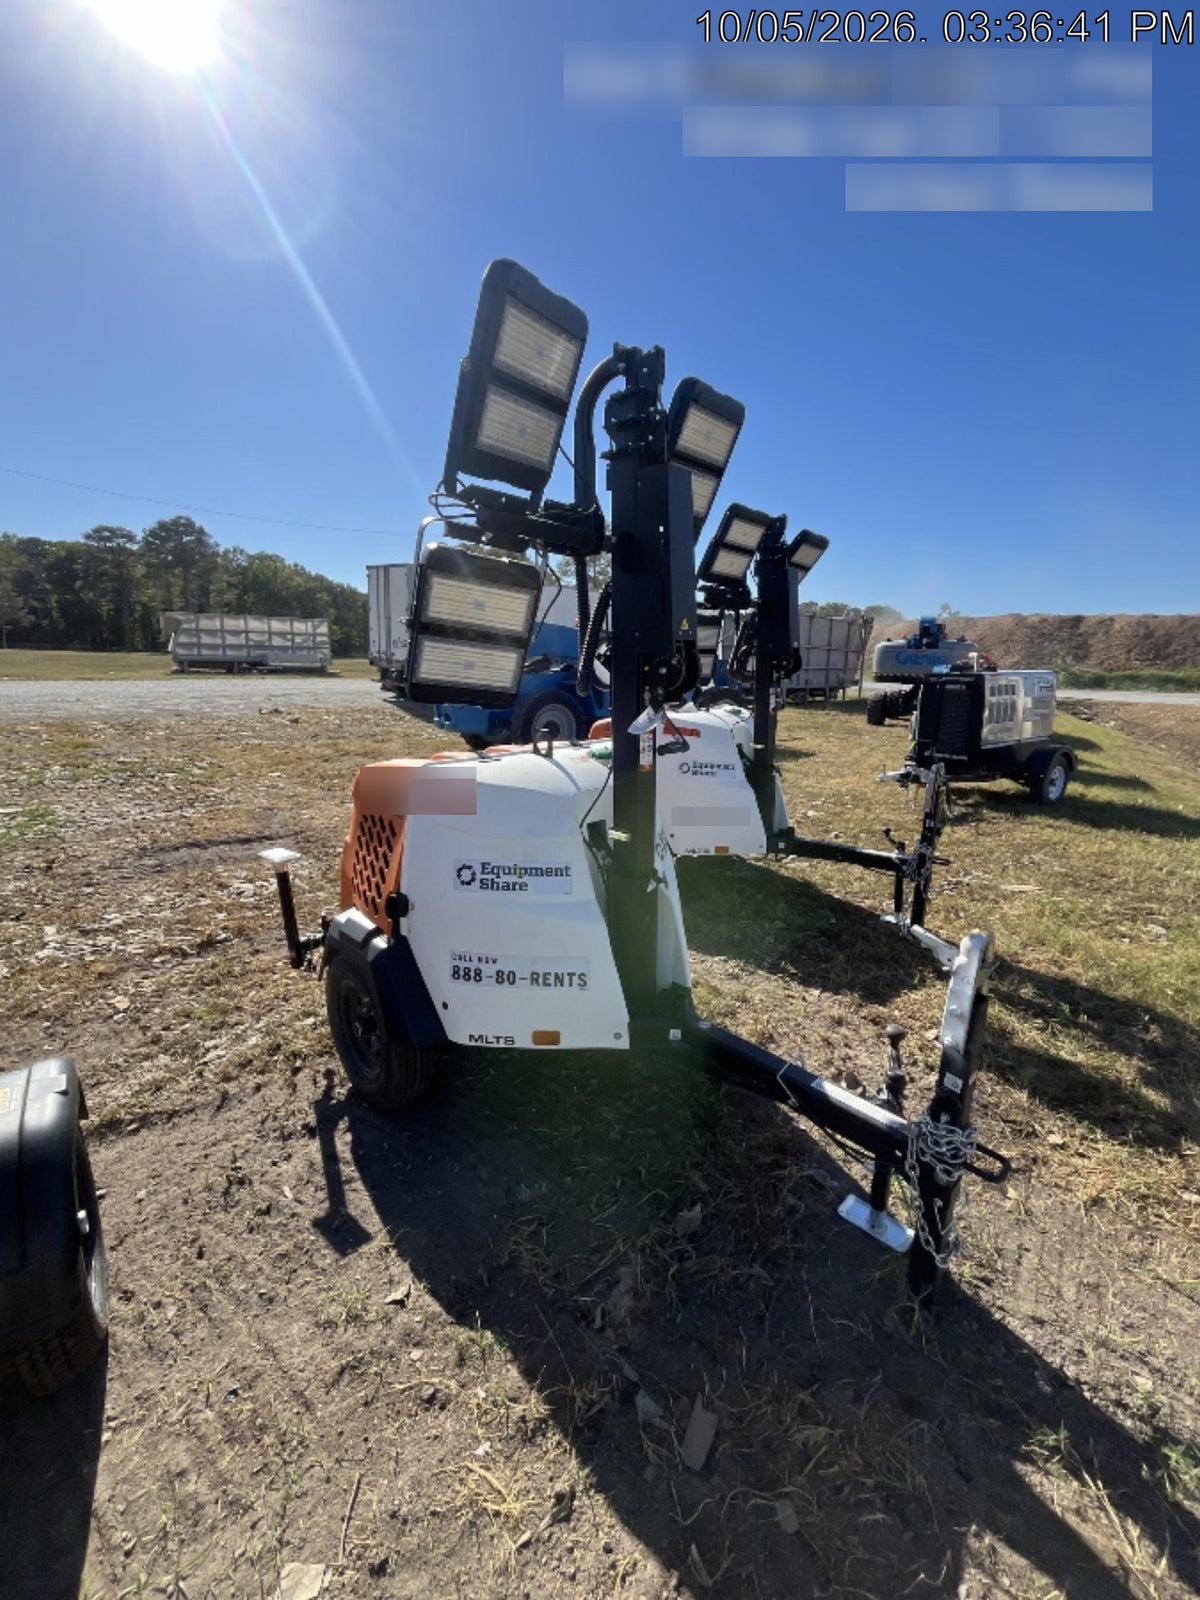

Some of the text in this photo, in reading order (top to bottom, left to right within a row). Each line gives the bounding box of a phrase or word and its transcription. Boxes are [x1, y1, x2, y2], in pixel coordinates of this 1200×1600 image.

[480, 862, 571, 880] Equipment
[480, 878, 529, 892] Share
[451, 965, 588, 988] 888-80-RENTS
